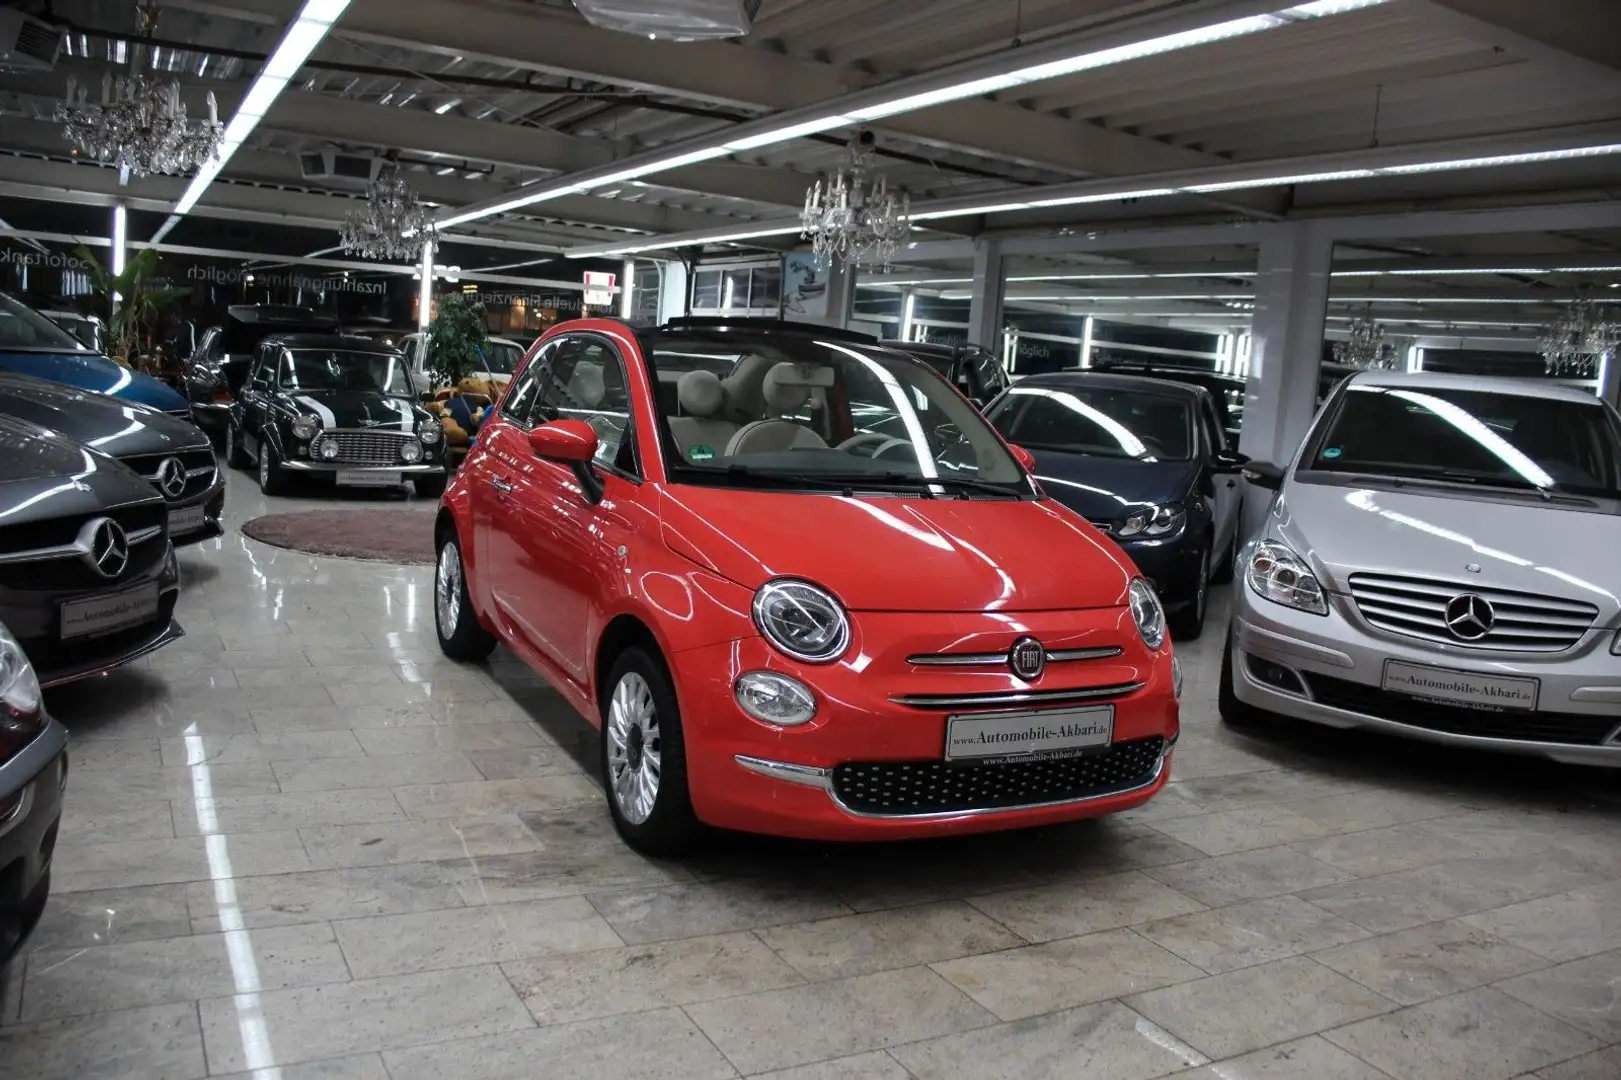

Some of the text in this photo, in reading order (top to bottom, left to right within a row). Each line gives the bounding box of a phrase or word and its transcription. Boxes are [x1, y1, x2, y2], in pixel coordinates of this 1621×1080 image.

[1021, 650, 1040, 668] FIAT
[1389, 675, 1531, 701] www.Automobile-Akbari.de
[953, 722, 1108, 746] www.Automobile-Akbari.de
[983, 750, 1083, 766] www.Automobile-Akbari.de
